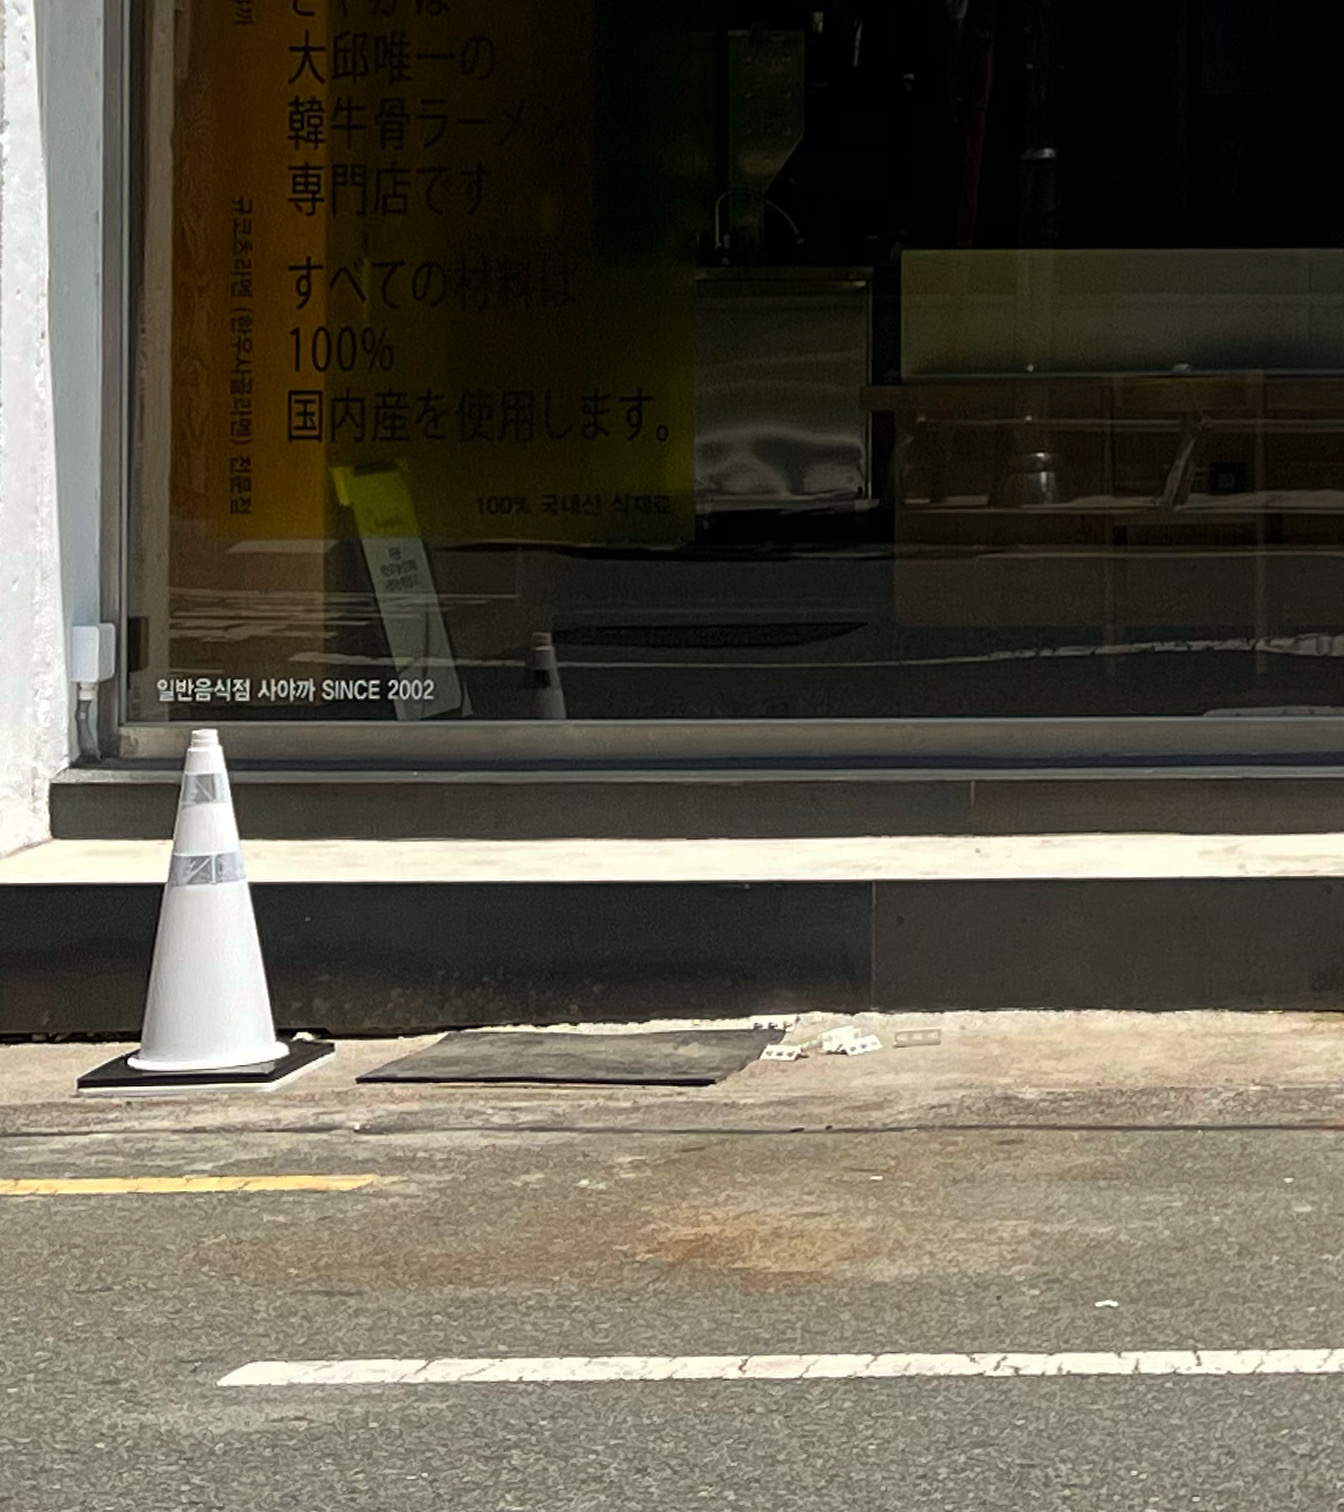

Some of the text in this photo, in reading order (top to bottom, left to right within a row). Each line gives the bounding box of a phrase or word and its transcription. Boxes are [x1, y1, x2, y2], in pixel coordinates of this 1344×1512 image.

[288, 326, 395, 373] 100%
[475, 495, 531, 515] 100%
[157, 678, 435, 703] 일반음식점 사야까 SINCE 2002
